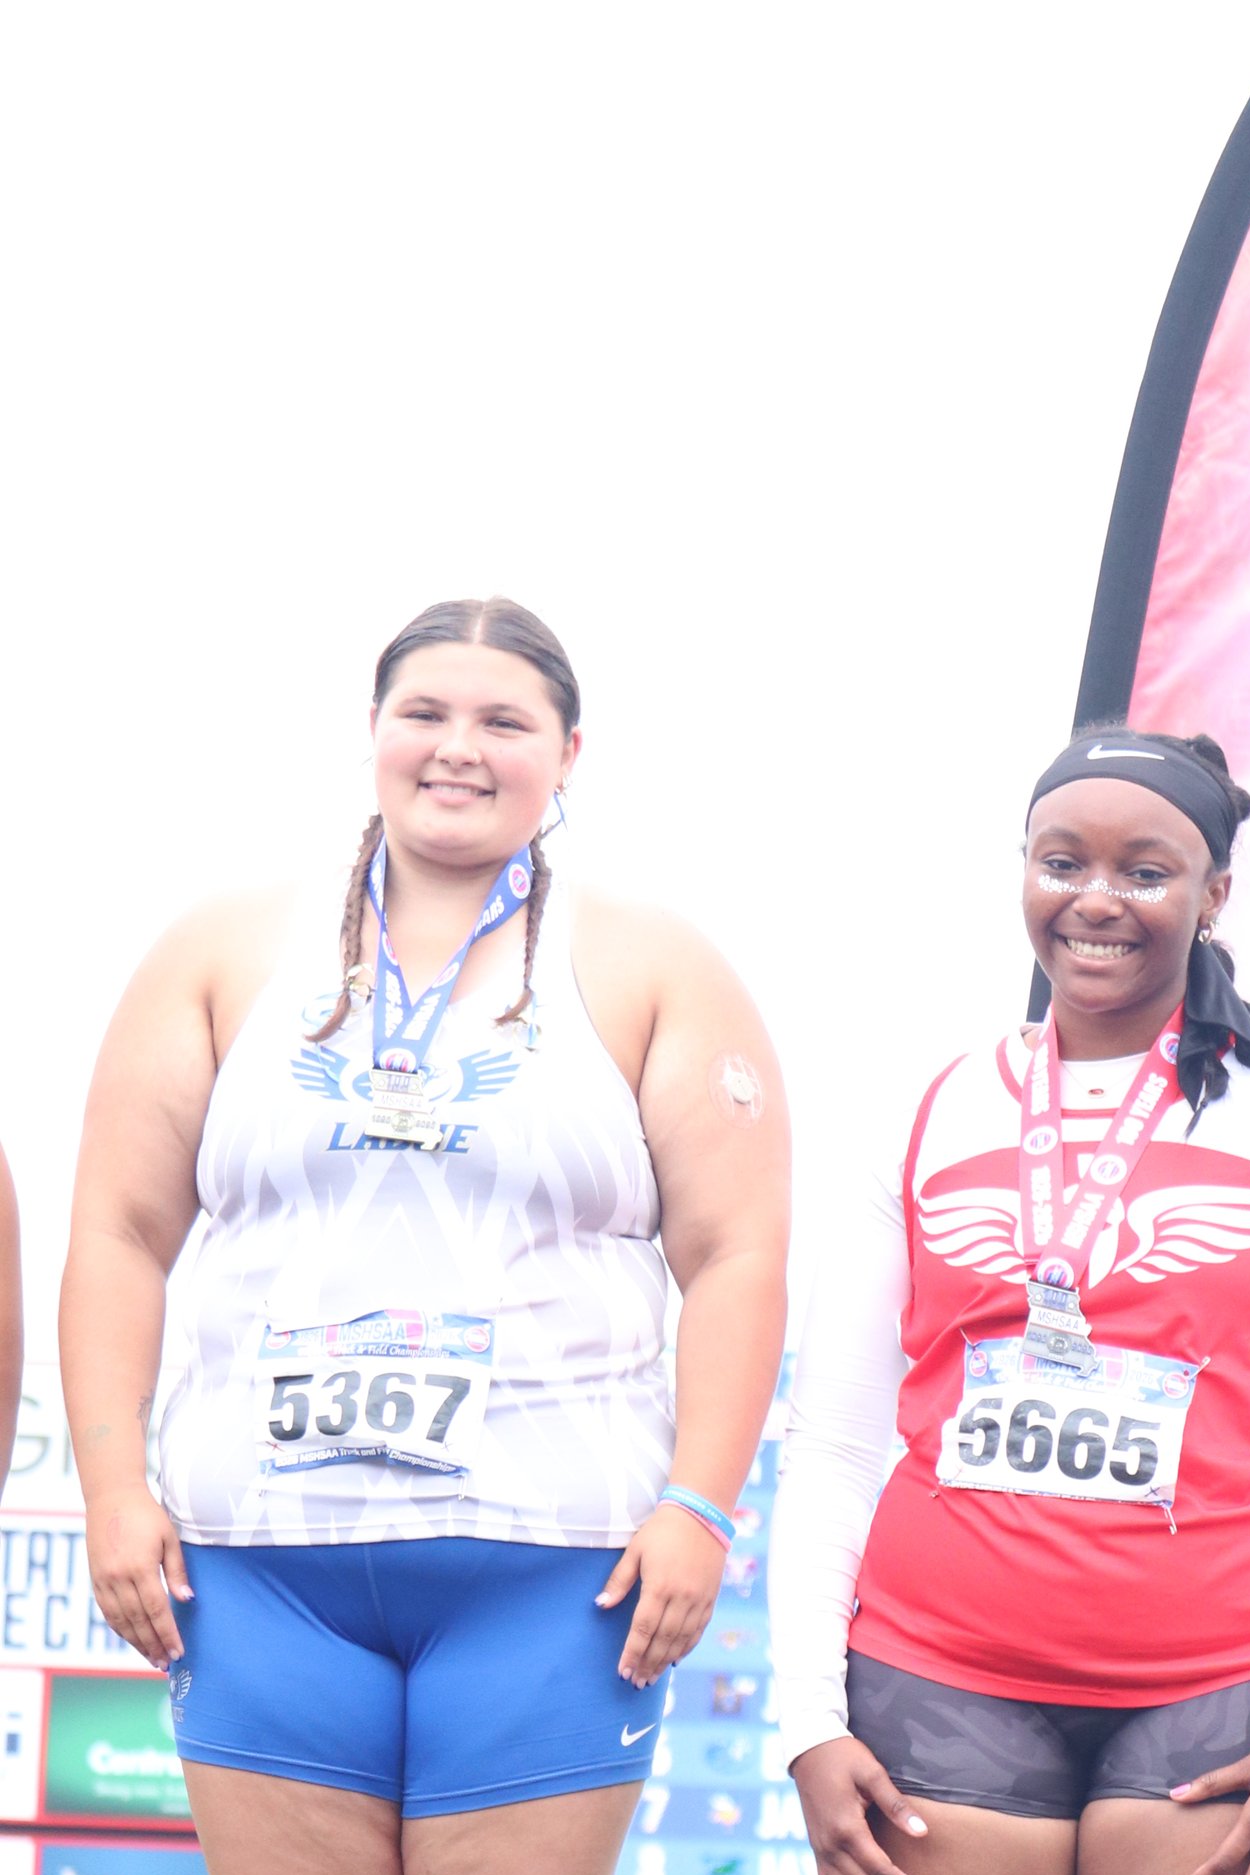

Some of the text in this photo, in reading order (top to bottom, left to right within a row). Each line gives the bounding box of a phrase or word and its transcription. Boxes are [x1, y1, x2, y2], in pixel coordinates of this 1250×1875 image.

[1036, 1309, 1080, 1331] MSHSAA
[339, 1322, 405, 1342] MSHSAA
[367, 1344, 388, 1356] Field
[268, 1370, 471, 1443] 5367
[958, 1397, 1161, 1486] 5665
